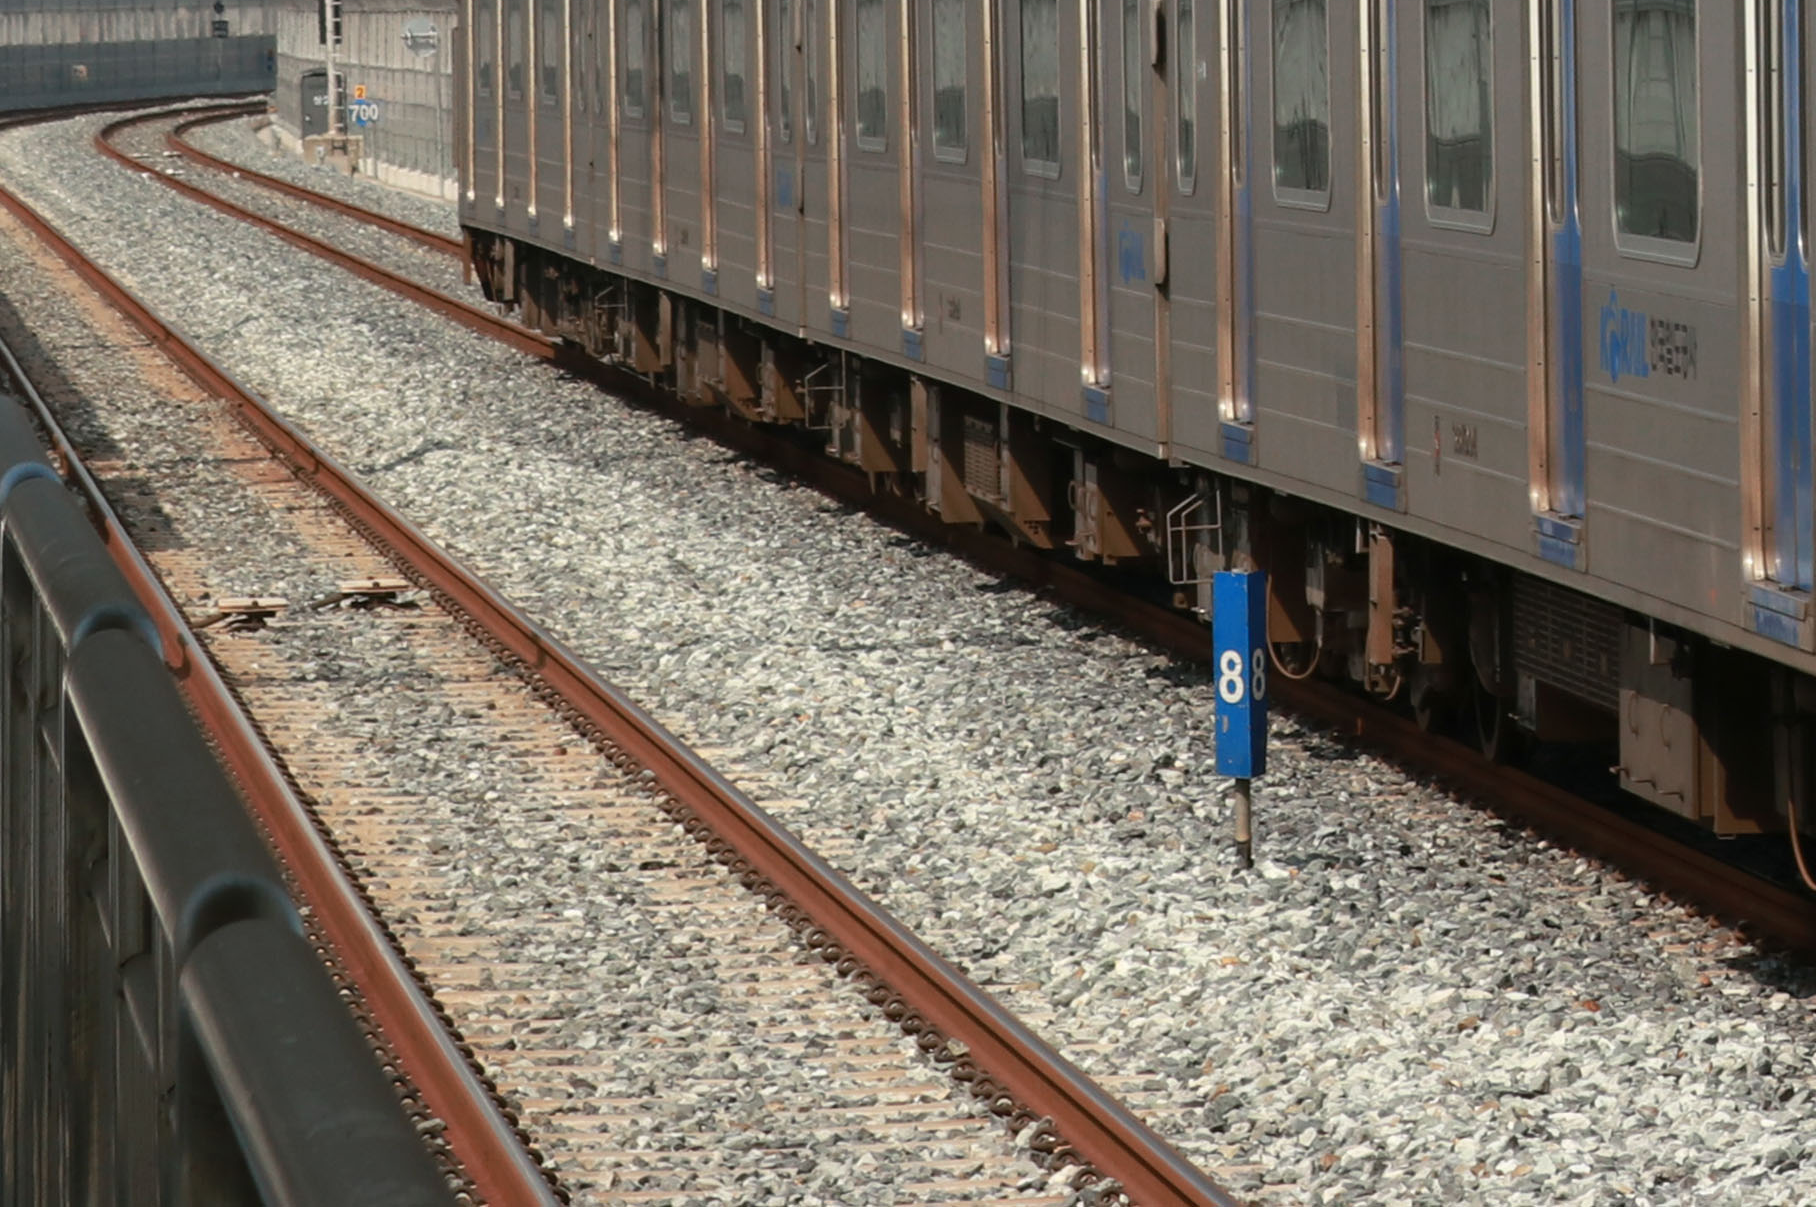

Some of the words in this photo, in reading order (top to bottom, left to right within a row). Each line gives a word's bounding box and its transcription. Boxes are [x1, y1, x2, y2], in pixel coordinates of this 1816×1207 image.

[348, 103, 379, 122] 700
[1218, 649, 1245, 704] 8
[1252, 647, 1266, 701] 8
